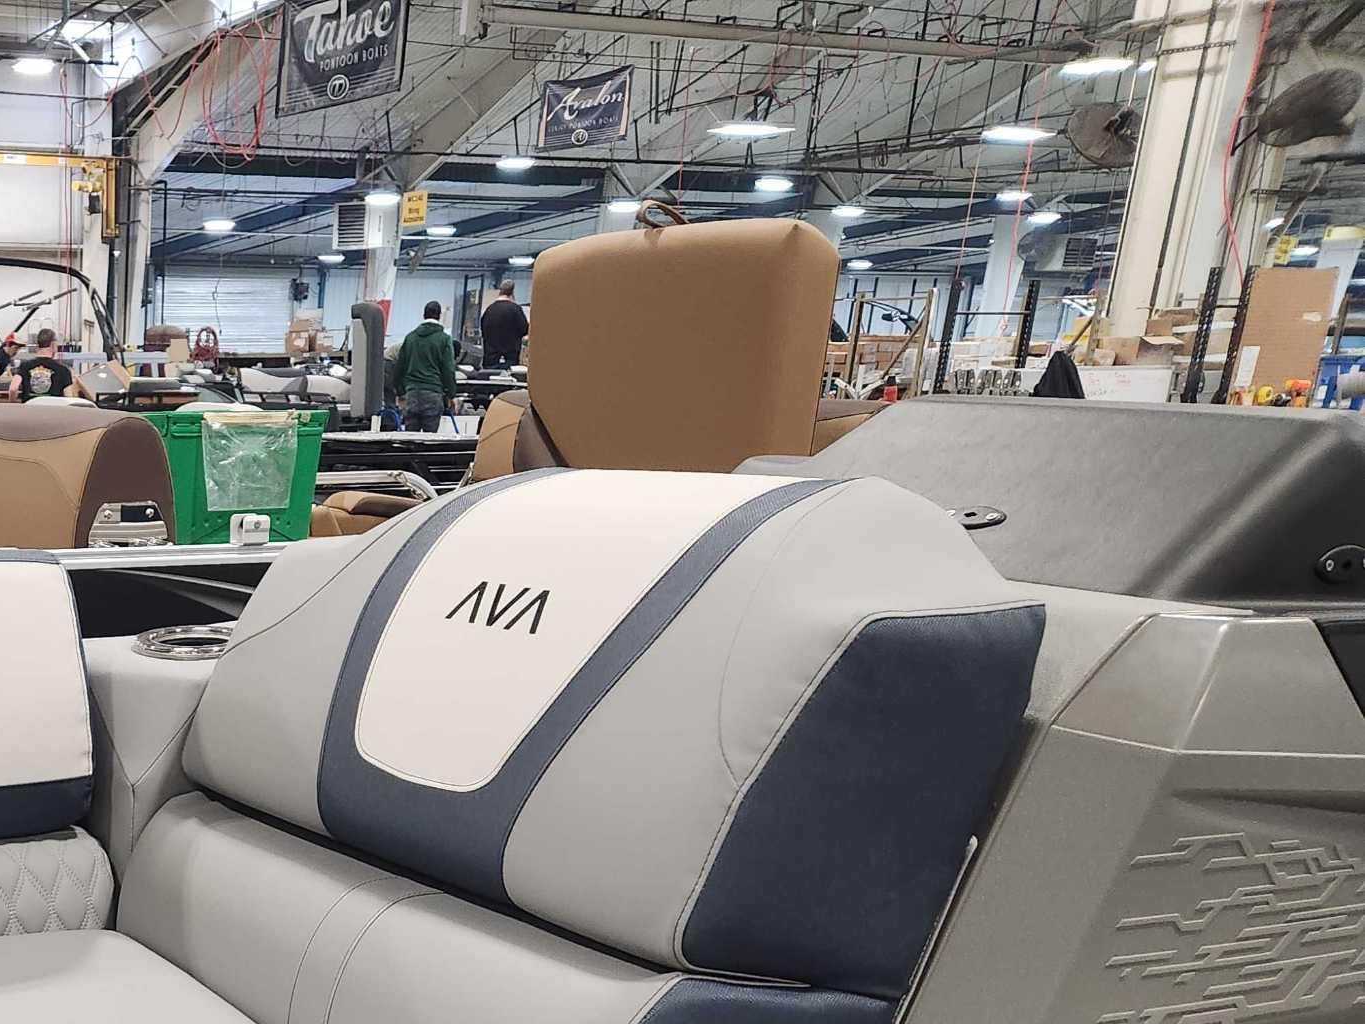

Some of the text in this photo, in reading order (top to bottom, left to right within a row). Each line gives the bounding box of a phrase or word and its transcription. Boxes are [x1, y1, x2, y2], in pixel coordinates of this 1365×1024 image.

[294, 0, 395, 63] Tahoe
[320, 44, 389, 72] PONTOON BOATS
[546, 80, 623, 120] Avalon
[445, 581, 550, 634] AVA
